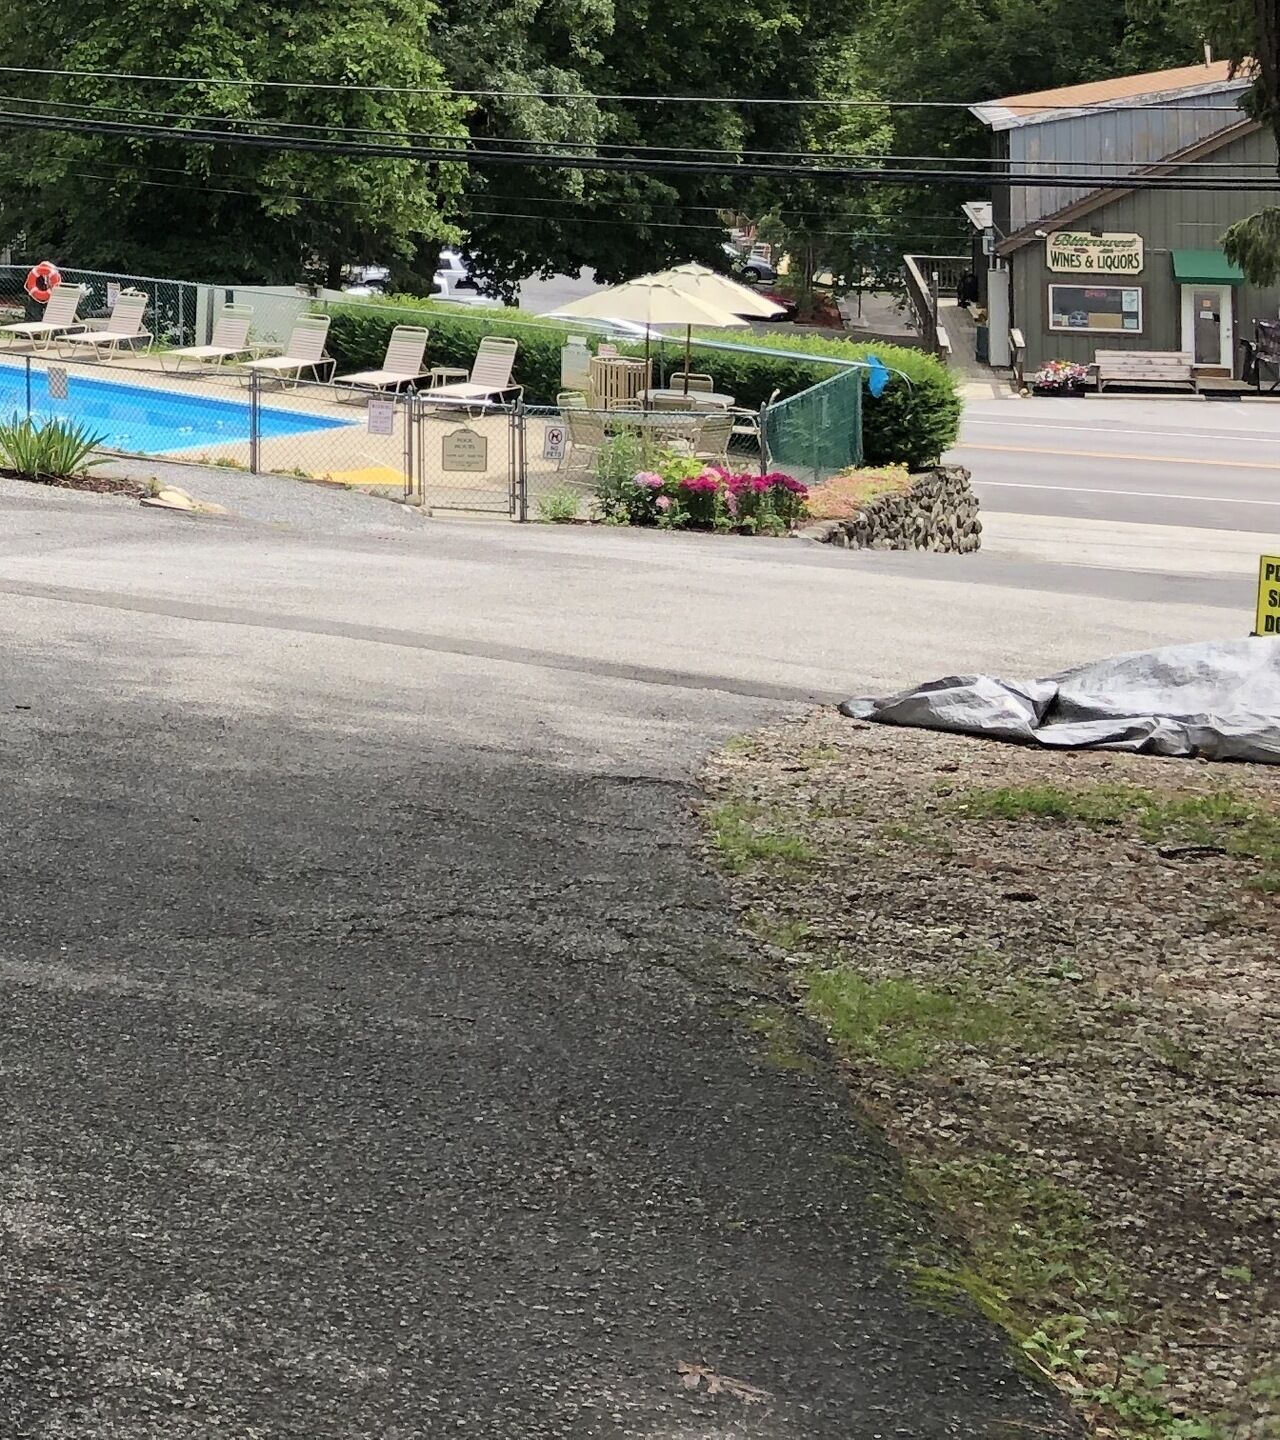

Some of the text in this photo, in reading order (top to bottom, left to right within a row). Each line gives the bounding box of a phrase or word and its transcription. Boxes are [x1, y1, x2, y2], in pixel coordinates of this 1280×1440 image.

[1050, 250, 1140, 270] WINES & LIQUORS
